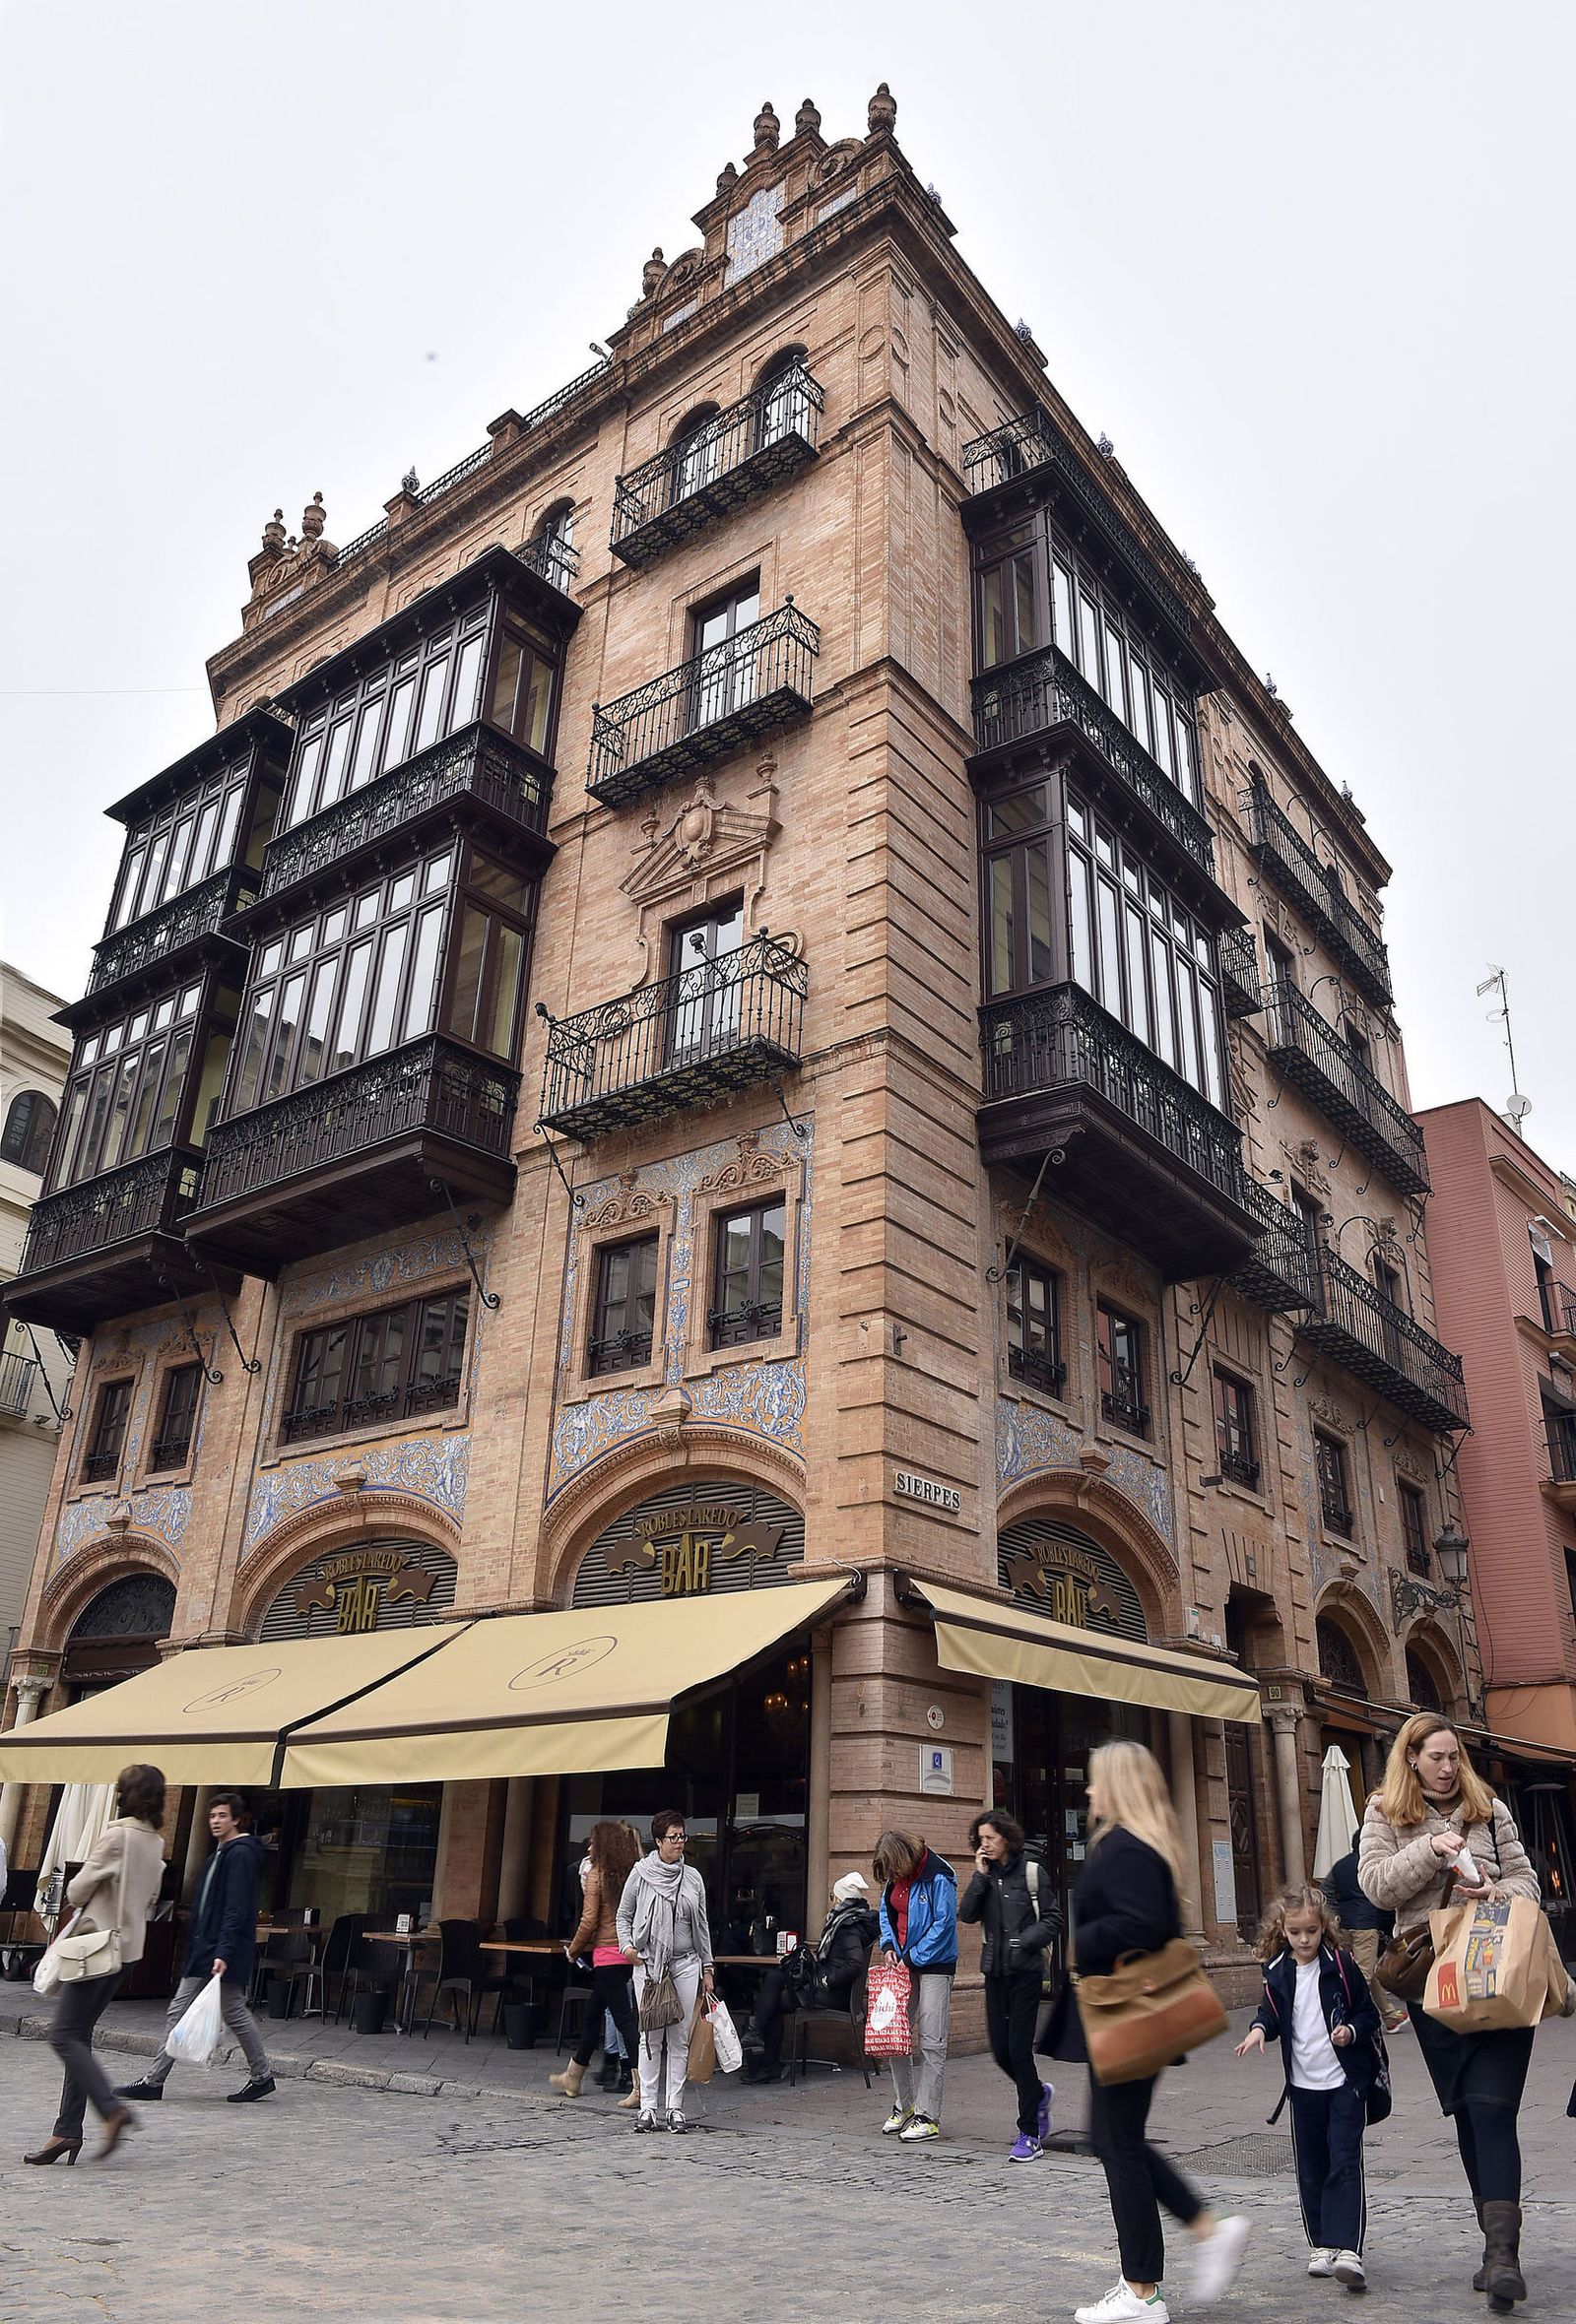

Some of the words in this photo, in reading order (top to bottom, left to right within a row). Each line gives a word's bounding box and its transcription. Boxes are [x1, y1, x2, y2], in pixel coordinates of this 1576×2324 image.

[896, 1473, 960, 1509] SIERPES
[641, 1510, 688, 1536] ROBLES
[689, 1508, 738, 1528] LAREDO
[325, 1555, 362, 1581] ROBLES
[362, 1552, 402, 1573] LAREDO
[660, 1533, 711, 1593] BAR
[1035, 1545, 1068, 1566] ROBLES
[1068, 1549, 1100, 1582] LAREDO
[336, 1576, 380, 1633] BAR
[1052, 1575, 1086, 1629] BAR
[1271, 1688, 1280, 1698] 90
